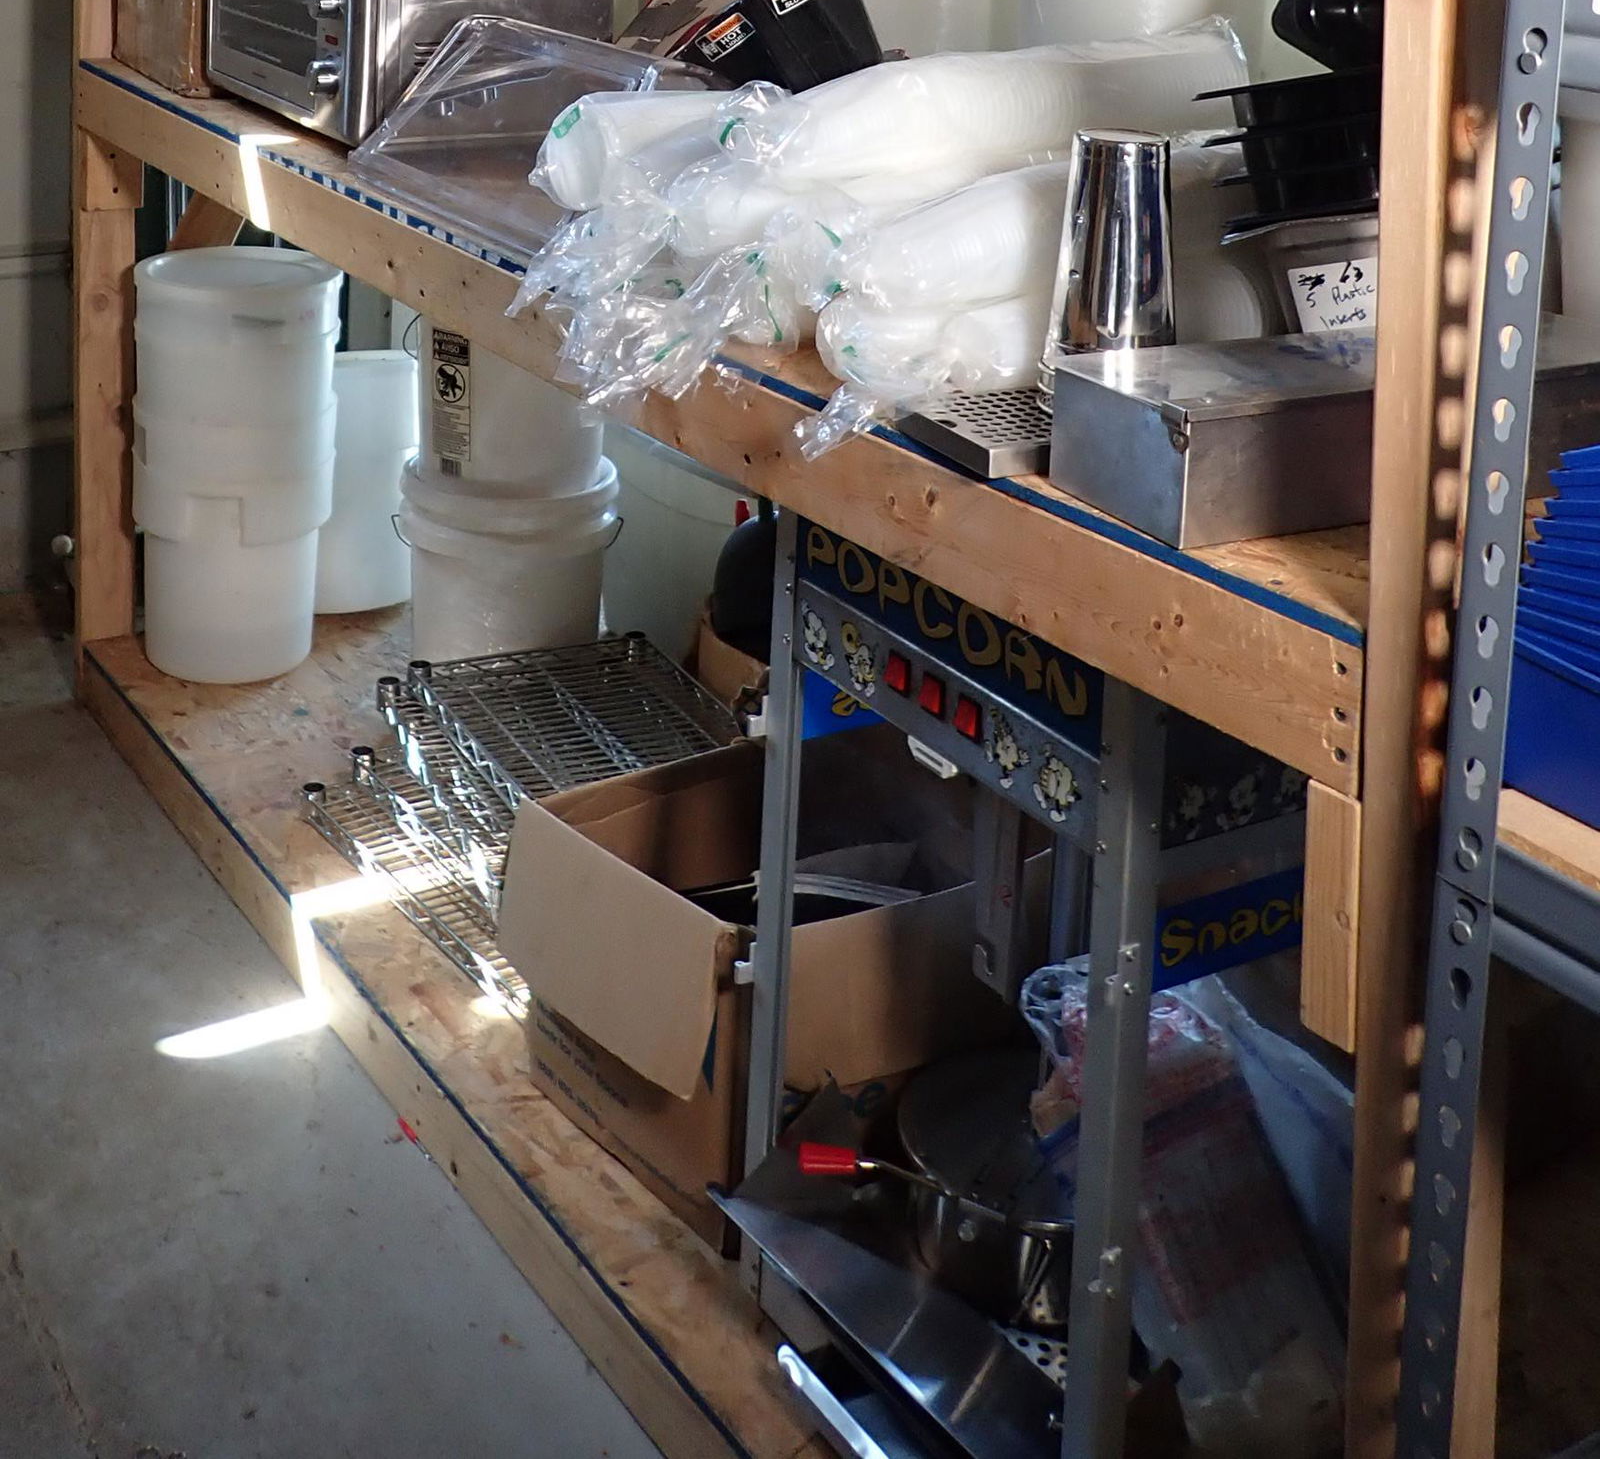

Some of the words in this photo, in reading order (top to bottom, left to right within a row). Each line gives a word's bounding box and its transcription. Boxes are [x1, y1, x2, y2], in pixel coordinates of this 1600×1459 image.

[720, 27, 742, 45] HOT
[1331, 284, 1375, 305] Plastic
[807, 526, 1088, 716] POPCORN
